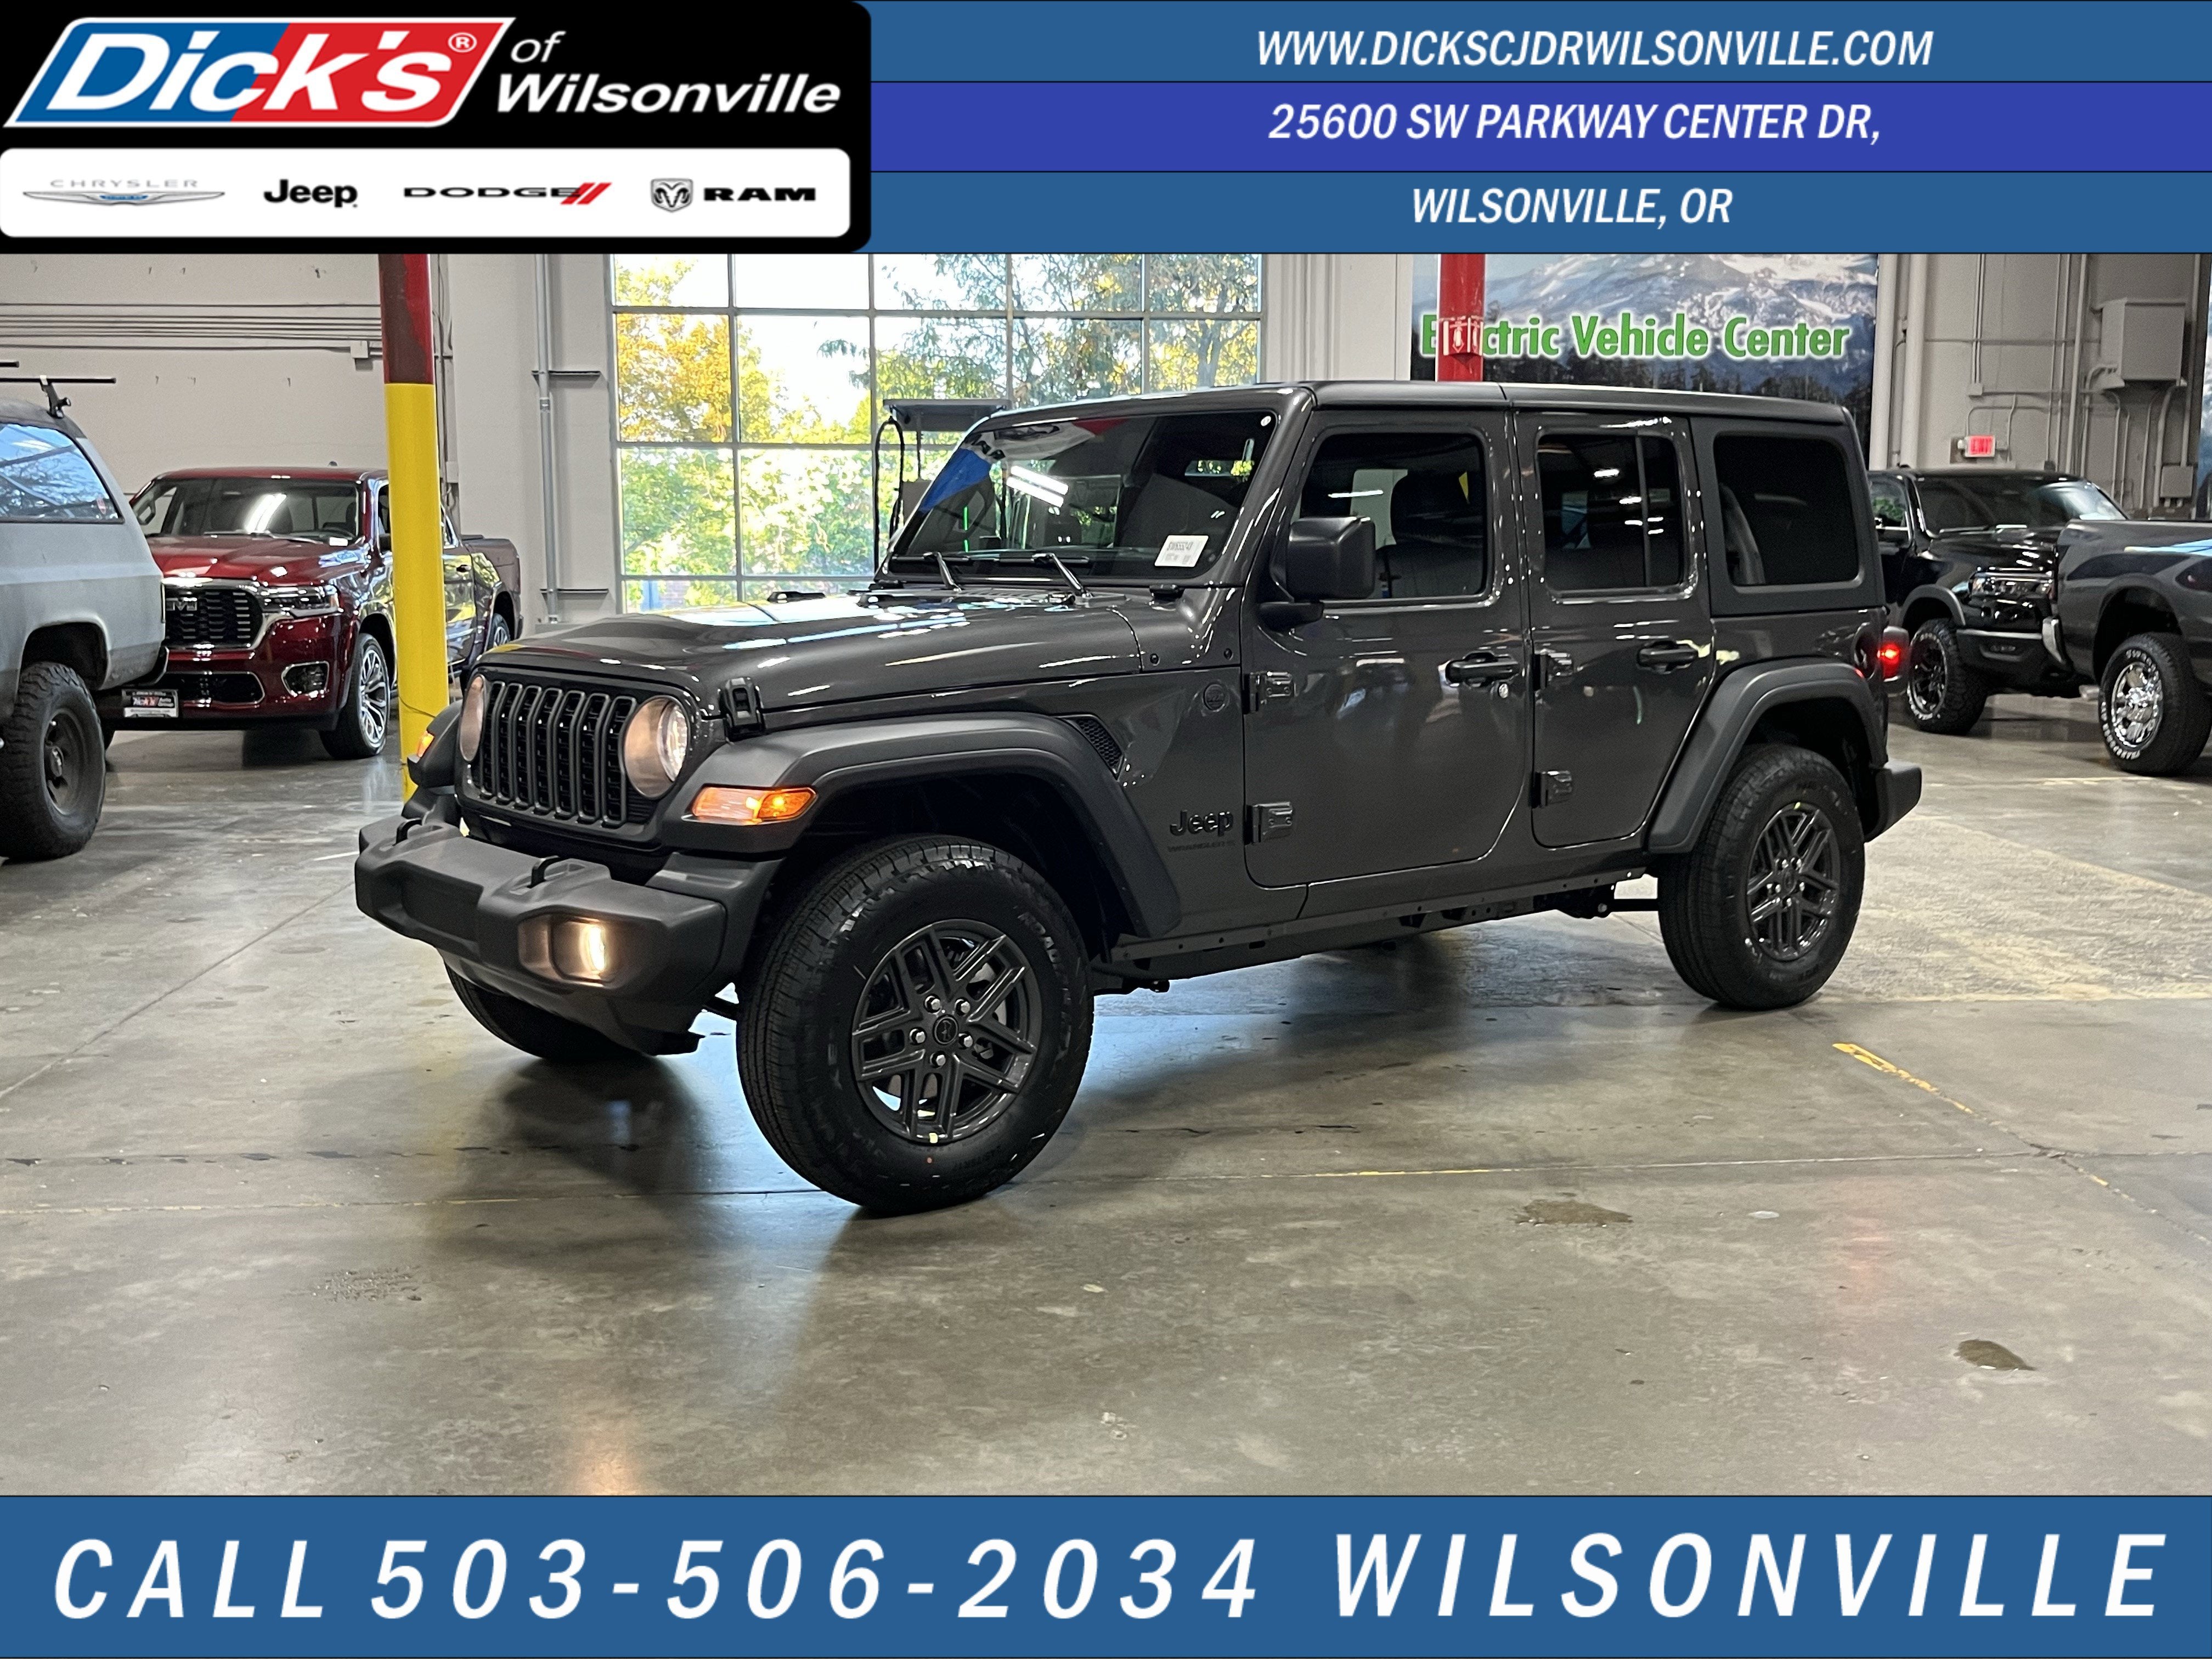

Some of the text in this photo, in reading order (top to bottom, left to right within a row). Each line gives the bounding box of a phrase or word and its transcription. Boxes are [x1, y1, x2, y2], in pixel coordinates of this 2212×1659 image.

[1421, 313, 1848, 357] Ectric Vehicle Center
[1169, 809, 1233, 837] Jeep
